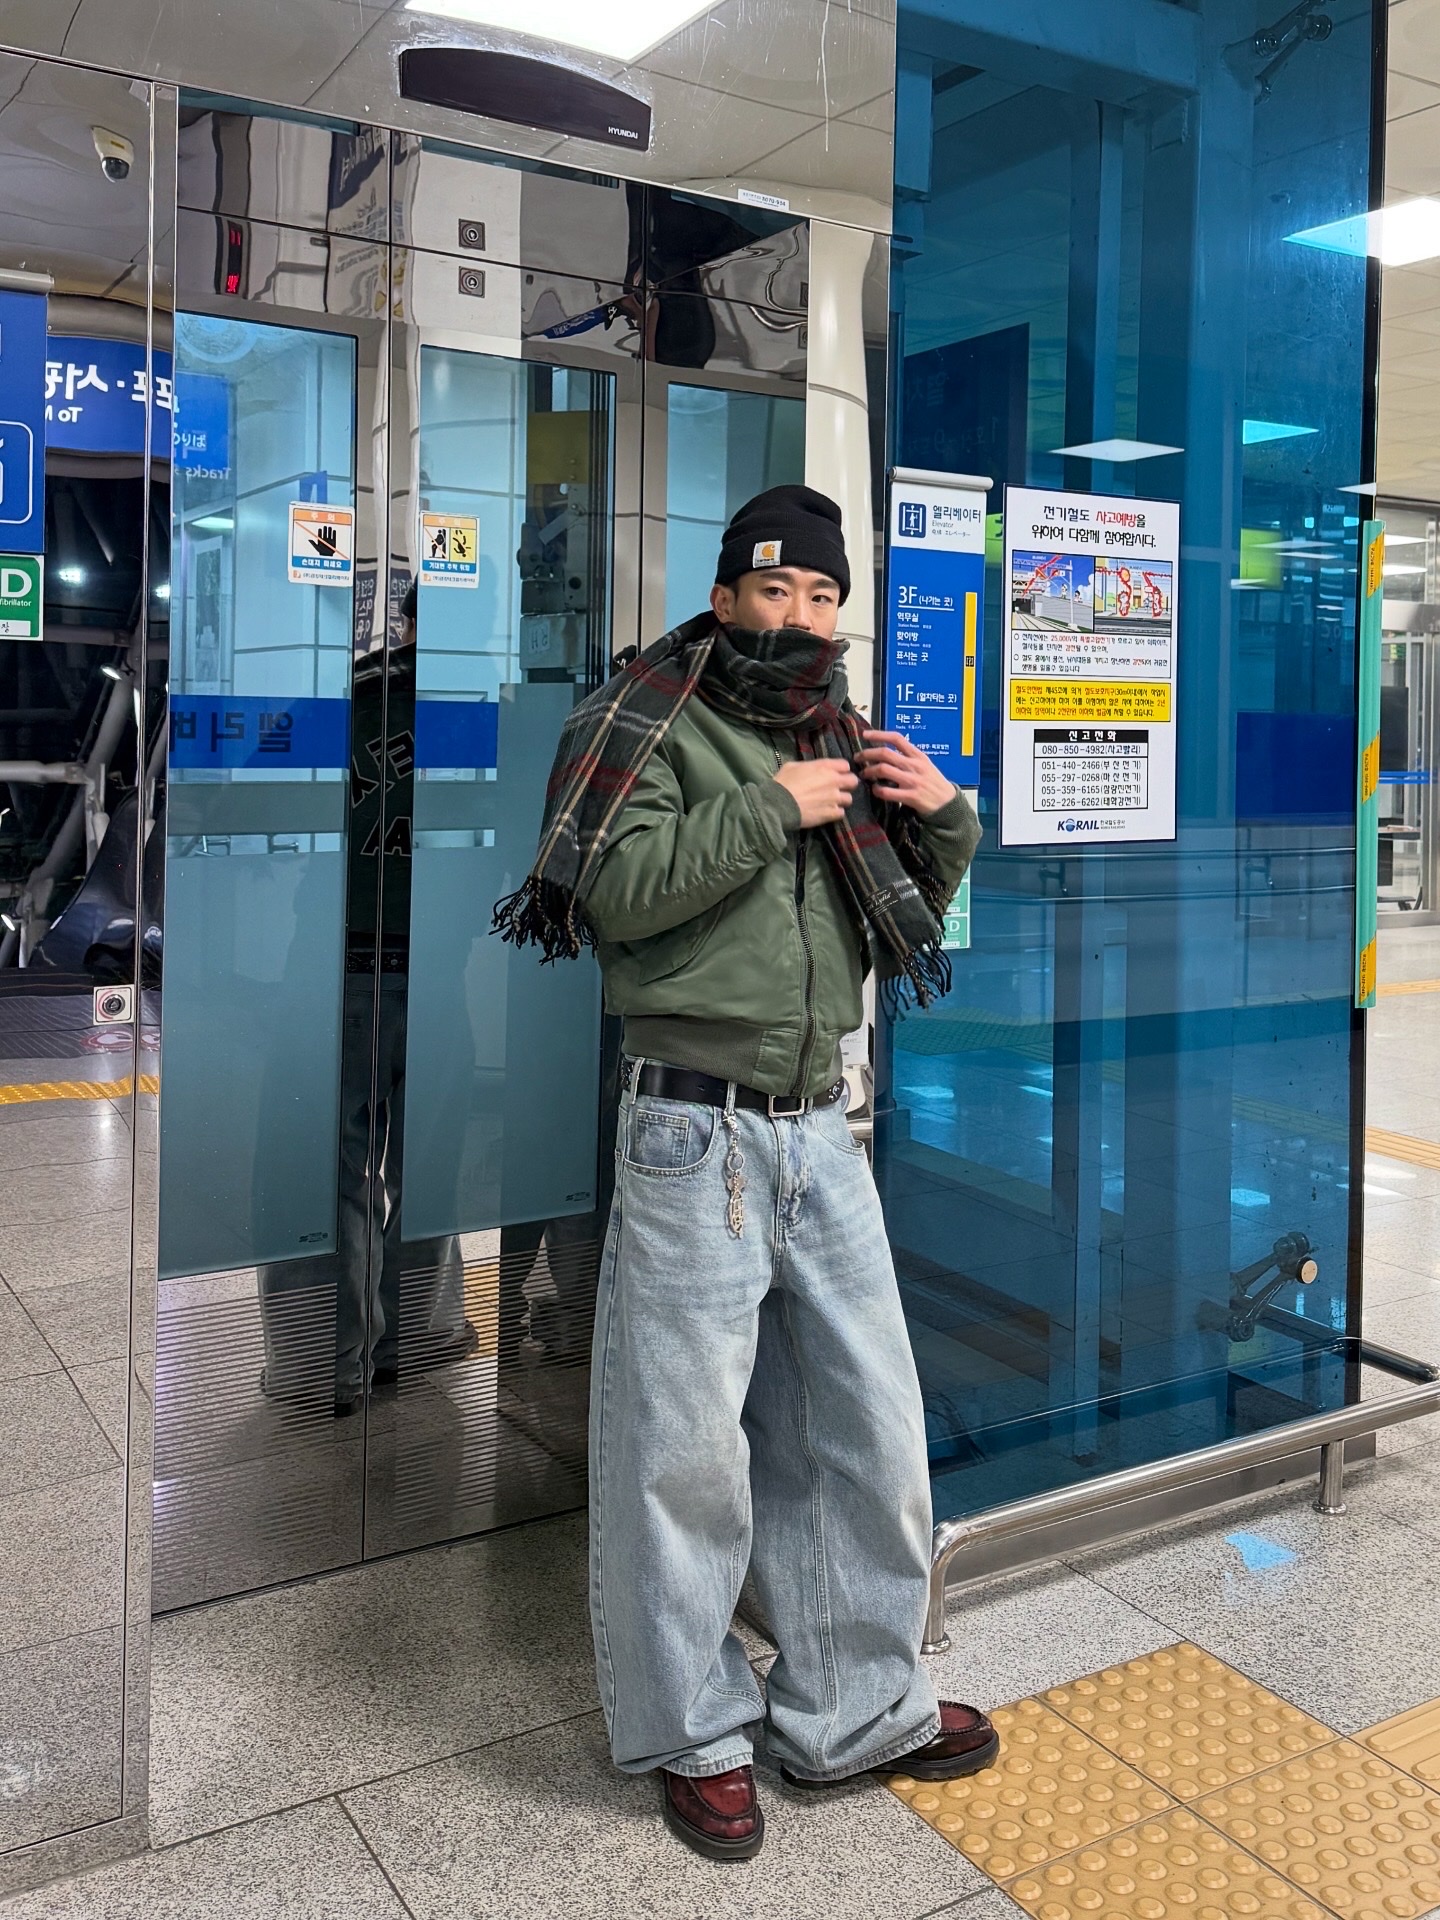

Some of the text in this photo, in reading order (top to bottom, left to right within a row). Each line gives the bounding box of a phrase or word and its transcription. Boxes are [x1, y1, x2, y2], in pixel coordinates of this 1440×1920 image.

[608, 126, 638, 139] HYUNDAI
[933, 505, 981, 523] 엘리베이터
[1043, 506, 1146, 528] 전기철도 사고예방을
[932, 520, 953, 528] Elevator
[1032, 525, 1156, 548] 위하여 다함께 참여합시다.
[302, 558, 343, 569] 손대지 마세요
[429, 562, 471, 572] 기대면 추락 위험
[898, 586, 917, 604] 3F
[944, 597, 953, 606] 곳)
[897, 612, 919, 622] 역무실
[896, 631, 919, 641] 맞이방
[896, 651, 928, 661] 표사는 곳
[896, 684, 957, 703] 1F (열차타는 곳)
[896, 714, 921, 723] 타는 곳
[1057, 819, 1099, 832] KORAIL
